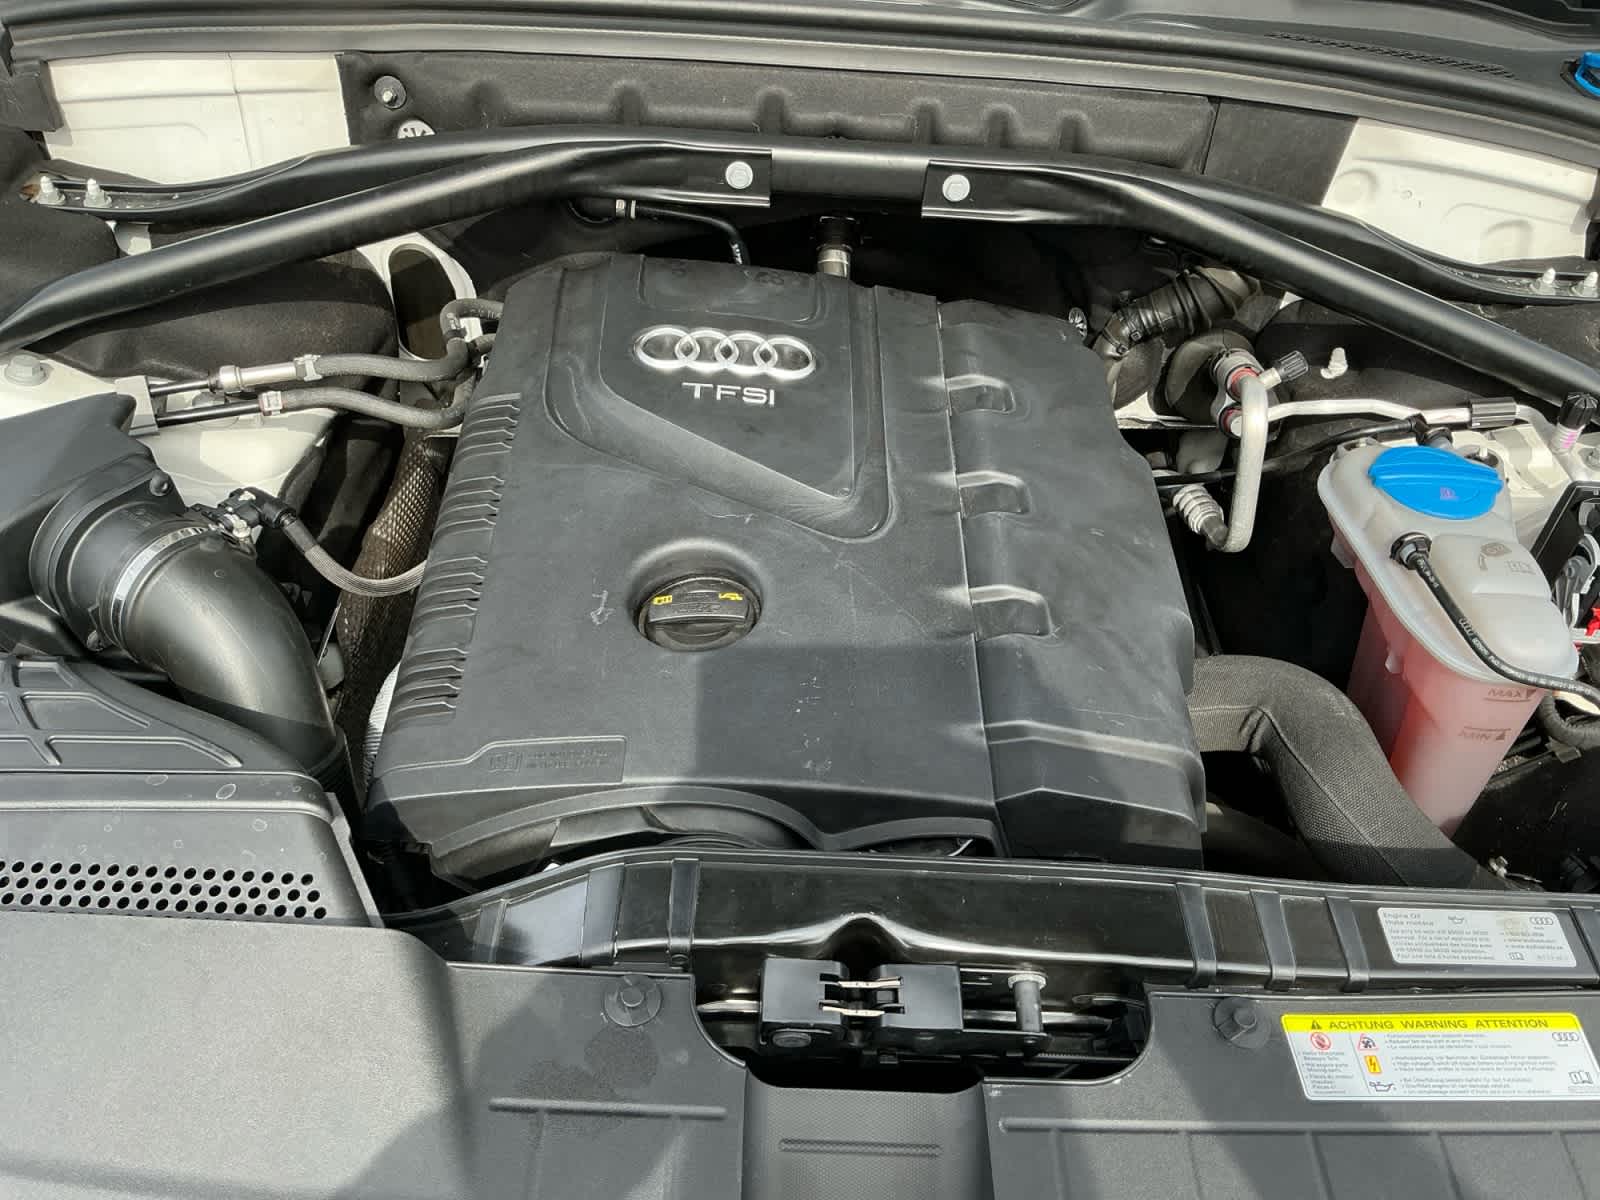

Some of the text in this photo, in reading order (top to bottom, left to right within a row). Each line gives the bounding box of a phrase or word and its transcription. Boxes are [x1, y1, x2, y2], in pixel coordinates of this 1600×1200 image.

[681, 382, 775, 408] TFSI
[1487, 688, 1522, 698] MAX
[1329, 1018, 1549, 1030] ACHTUNG WARNING ATTENTION
